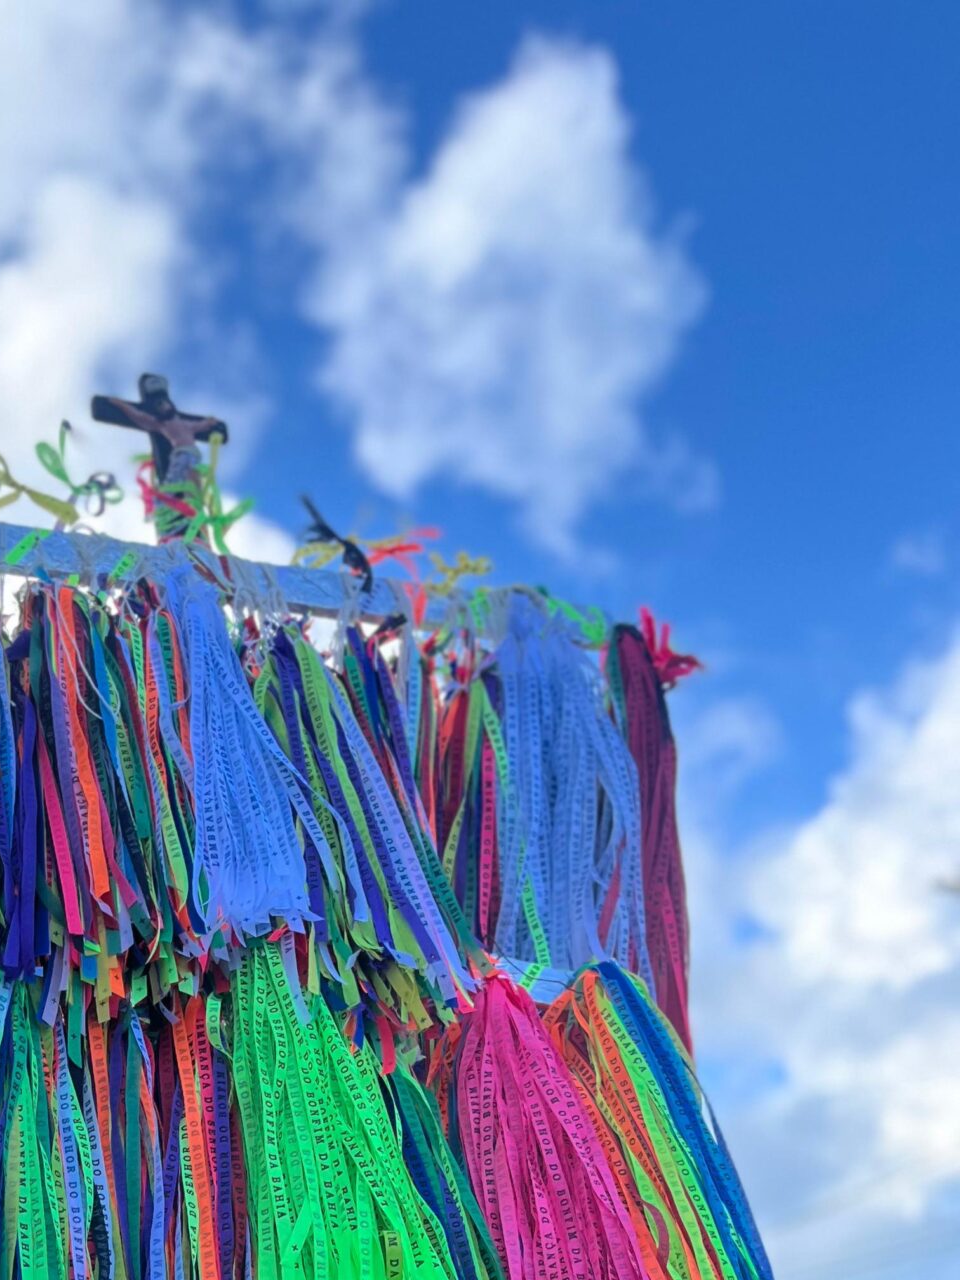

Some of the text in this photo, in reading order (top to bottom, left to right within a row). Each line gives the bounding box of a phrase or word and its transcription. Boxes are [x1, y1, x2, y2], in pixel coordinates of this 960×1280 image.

[228, 681, 323, 842] DO SENHOR DA BAHIA
[274, 975, 284, 988] DO
[267, 1001, 287, 1099] DO SENHOR DO
[601, 1008, 662, 1096] LEMBRANÇA DO
[610, 1058, 621, 1074] DO
[59, 1093, 68, 1109] DO
[204, 1097, 213, 1113] DO
[326, 1036, 377, 1136] DO SENHOR DO
[529, 1061, 572, 1124] DO BONFIM
[264, 1092, 276, 1147] BONFIM
[306, 1092, 325, 1145] BONFIM
[571, 1114, 584, 1131] DO
[625, 1129, 636, 1146] DO
[62, 1118, 76, 1173] SENHOR
[93, 1159, 101, 1176] DO
[267, 1153, 278, 1169] DA
[319, 1154, 330, 1171] DA
[483, 1071, 500, 1231] DO SENHOR DO BONFIM
[613, 1158, 627, 1177] DO
[69, 1182, 78, 1198] DO
[523, 1081, 535, 1098] DO
[530, 1103, 555, 1155] SENHOR
[550, 1163, 560, 1181] DO
[557, 1190, 578, 1240] BONFIM
[571, 1247, 582, 1264] DA
[271, 1177, 287, 1219] BAHIA
[323, 1181, 339, 1229] BAHIA
[540, 1206, 550, 1224] DO
[676, 1159, 690, 1176] DO
[688, 1184, 718, 1239] BONFIM
[717, 1248, 728, 1266] DA
[19, 1197, 31, 1268] DA BAHIA
[71, 1208, 84, 1264] BONFIM
[390, 1259, 400, 1278] DA
